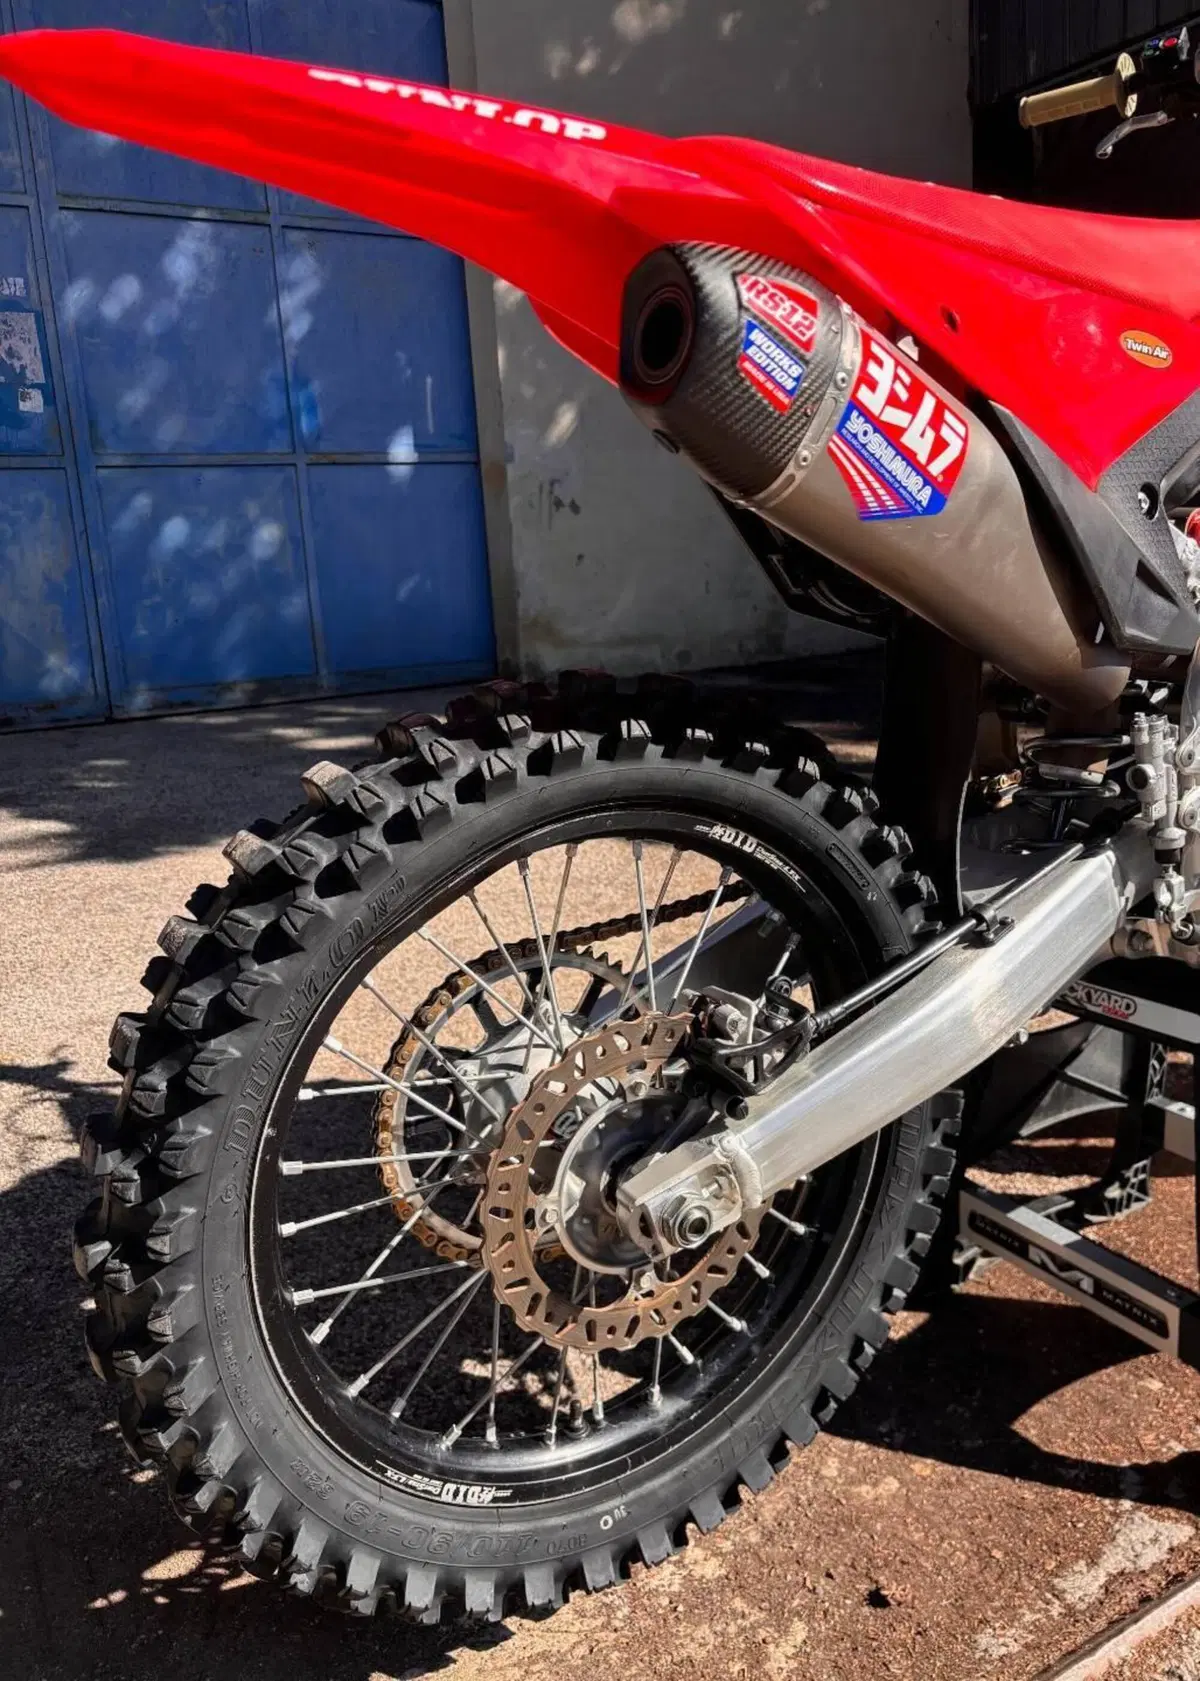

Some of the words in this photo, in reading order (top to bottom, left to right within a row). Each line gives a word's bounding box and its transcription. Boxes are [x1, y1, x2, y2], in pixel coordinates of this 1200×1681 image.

[745, 345, 798, 391] EDITION
[748, 328, 804, 379] WORKS
[1124, 337, 1154, 356] Twin
[1153, 344, 1170, 360] Air
[845, 410, 933, 508] YOSHIMURA
[223, 869, 408, 1152] DUNLOP
